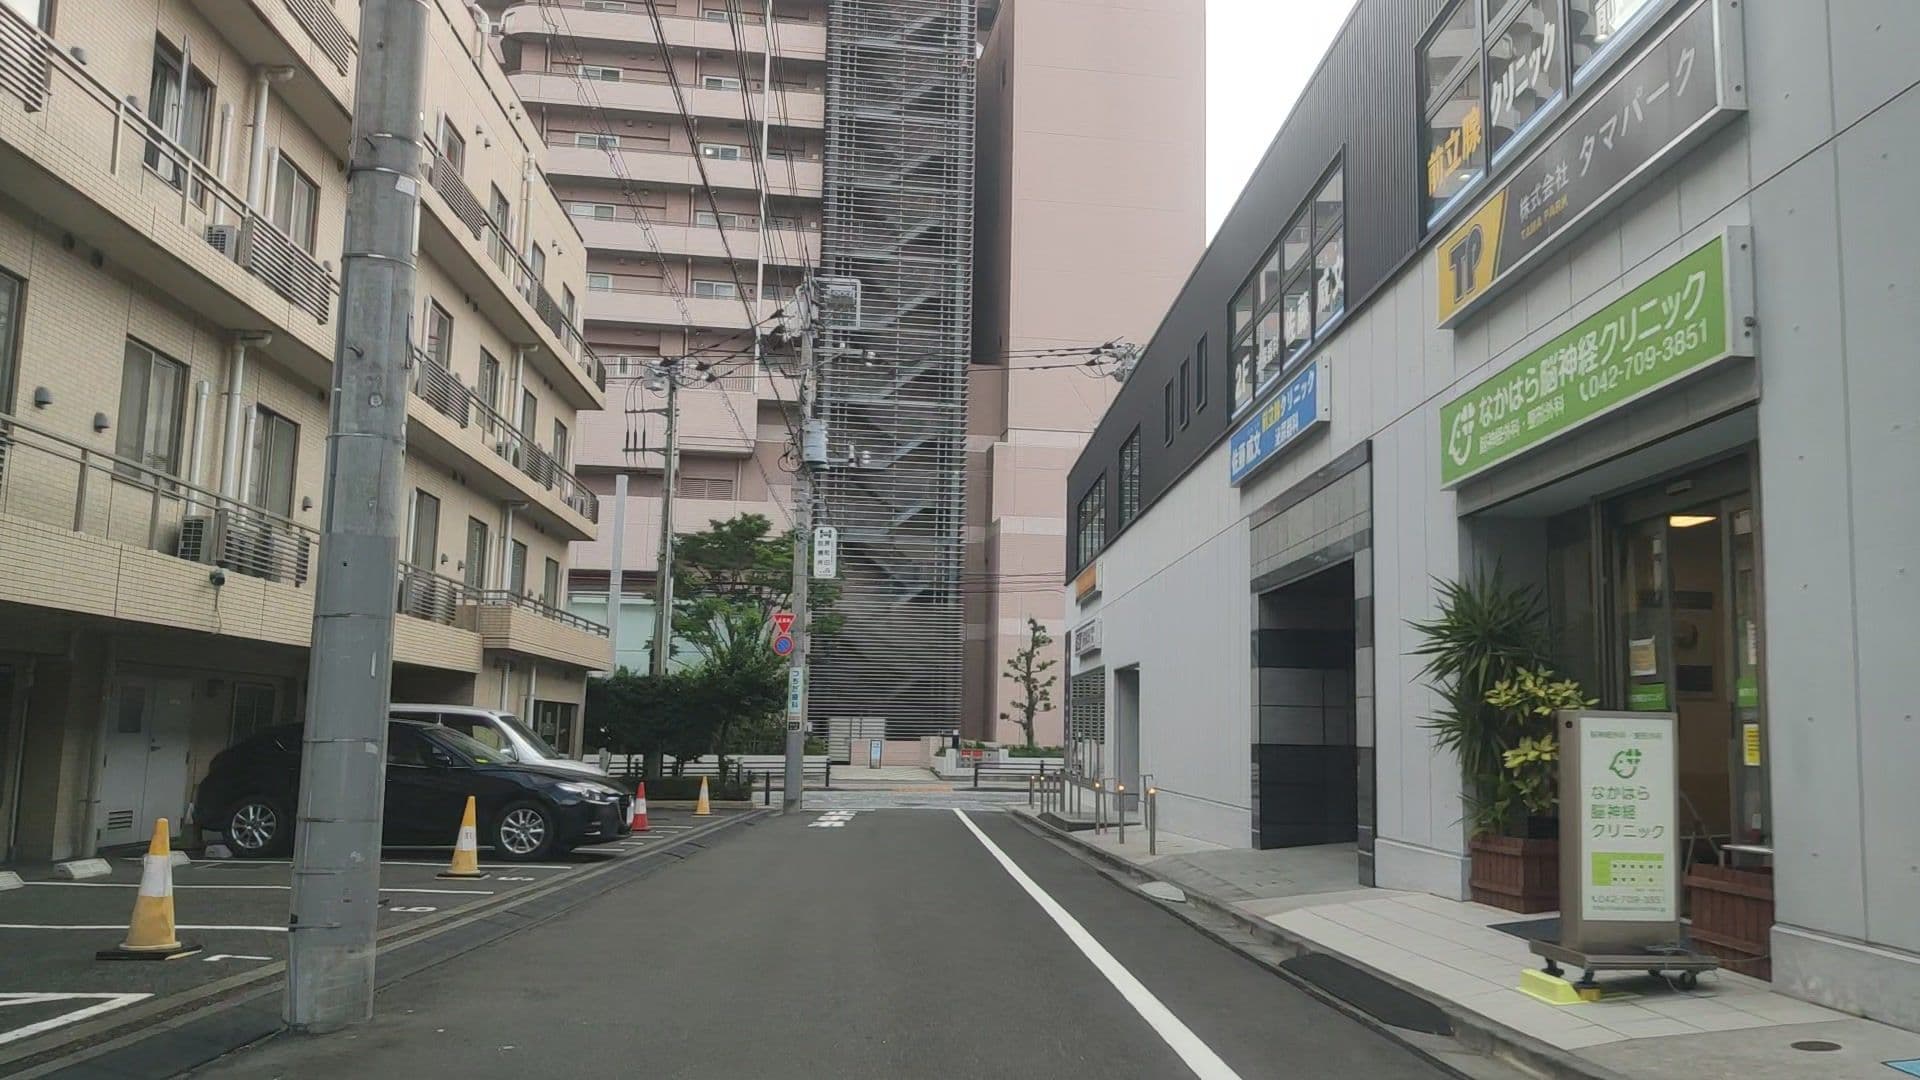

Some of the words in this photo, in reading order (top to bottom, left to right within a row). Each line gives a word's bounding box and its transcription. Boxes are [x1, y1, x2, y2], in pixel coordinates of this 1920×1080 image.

[1491, 22, 1556, 126] クリニック
[1519, 160, 1569, 223] 株式会社
[1580, 47, 1695, 177] タマパーク
[1480, 271, 1706, 428] なかはら脳神経クリニック
[1591, 786, 1651, 801] なかはら
[1592, 824, 1665, 839] クリニック
